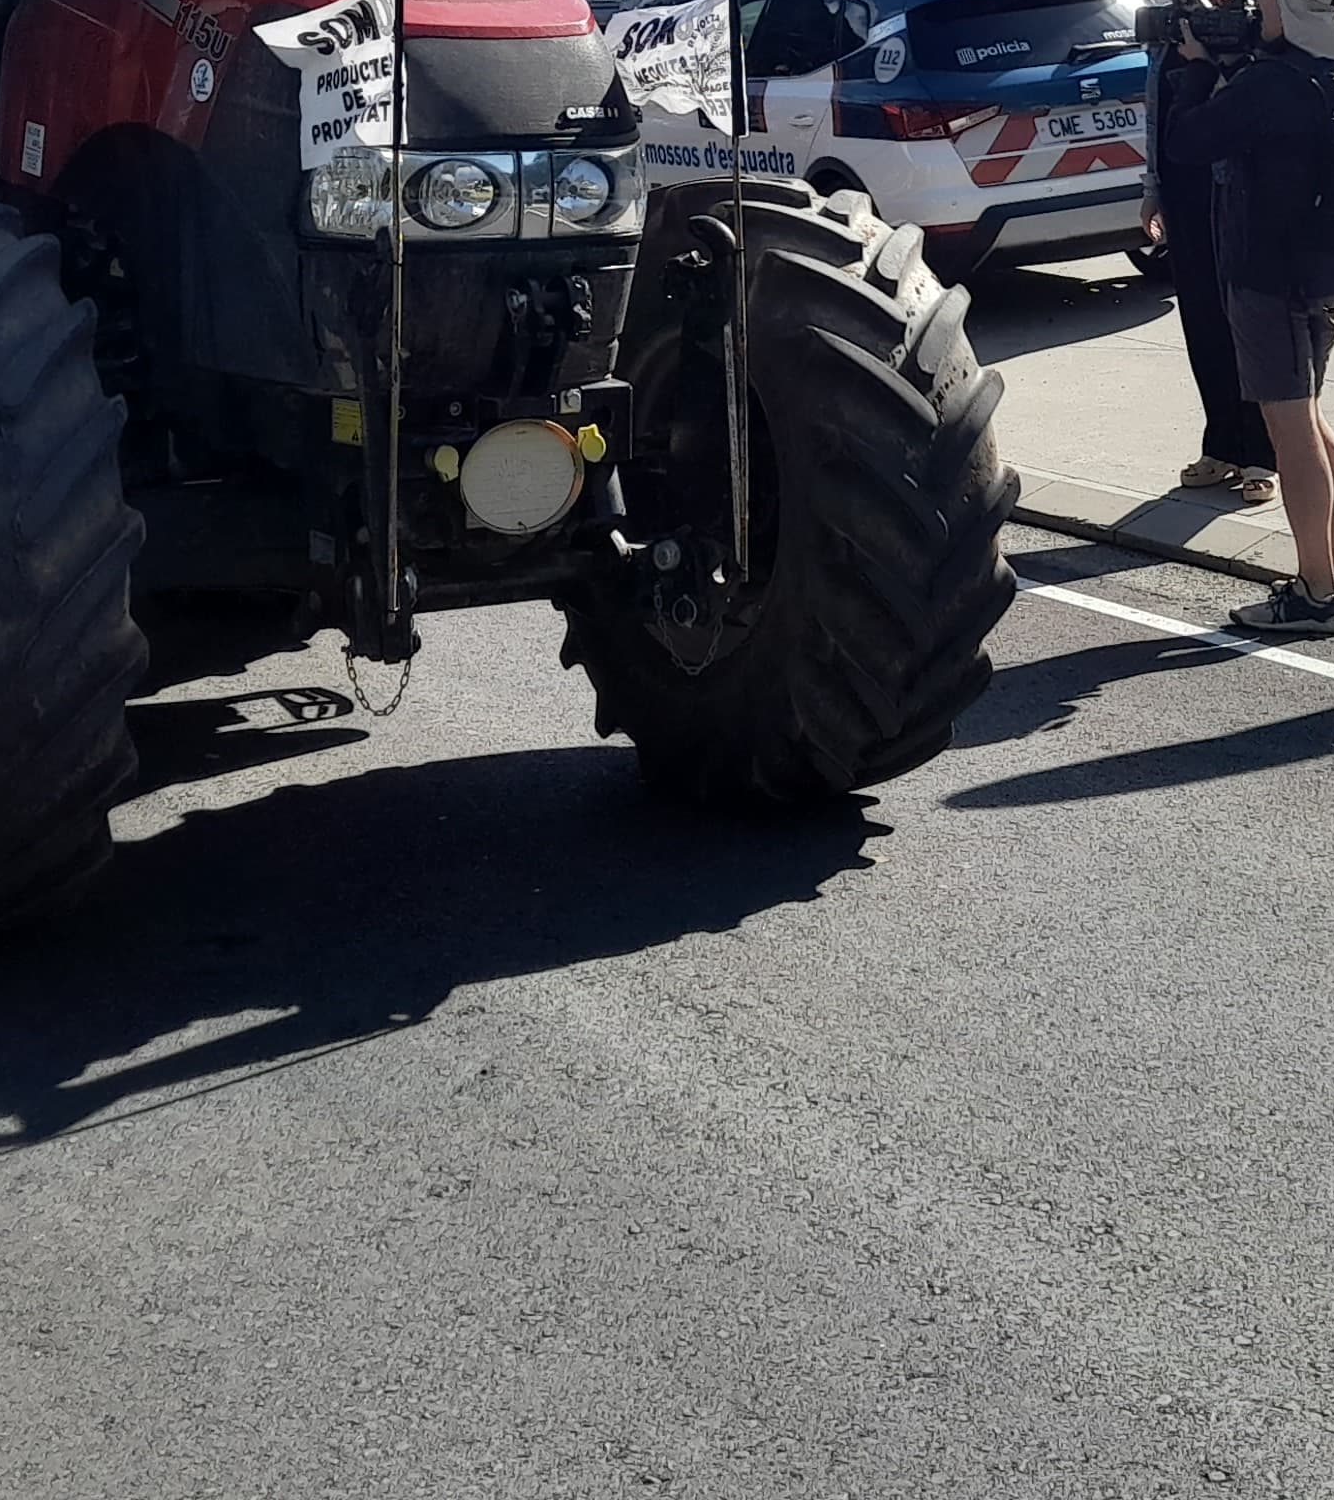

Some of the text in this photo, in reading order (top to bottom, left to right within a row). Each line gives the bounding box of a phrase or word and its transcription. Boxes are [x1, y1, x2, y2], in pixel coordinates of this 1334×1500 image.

[177, 0, 230, 62] 115U
[880, 49, 900, 66] 112
[977, 40, 1031, 61] policia
[343, 88, 367, 112] DE
[1048, 108, 1137, 138] CME 5360
[645, 143, 700, 167] mossos
